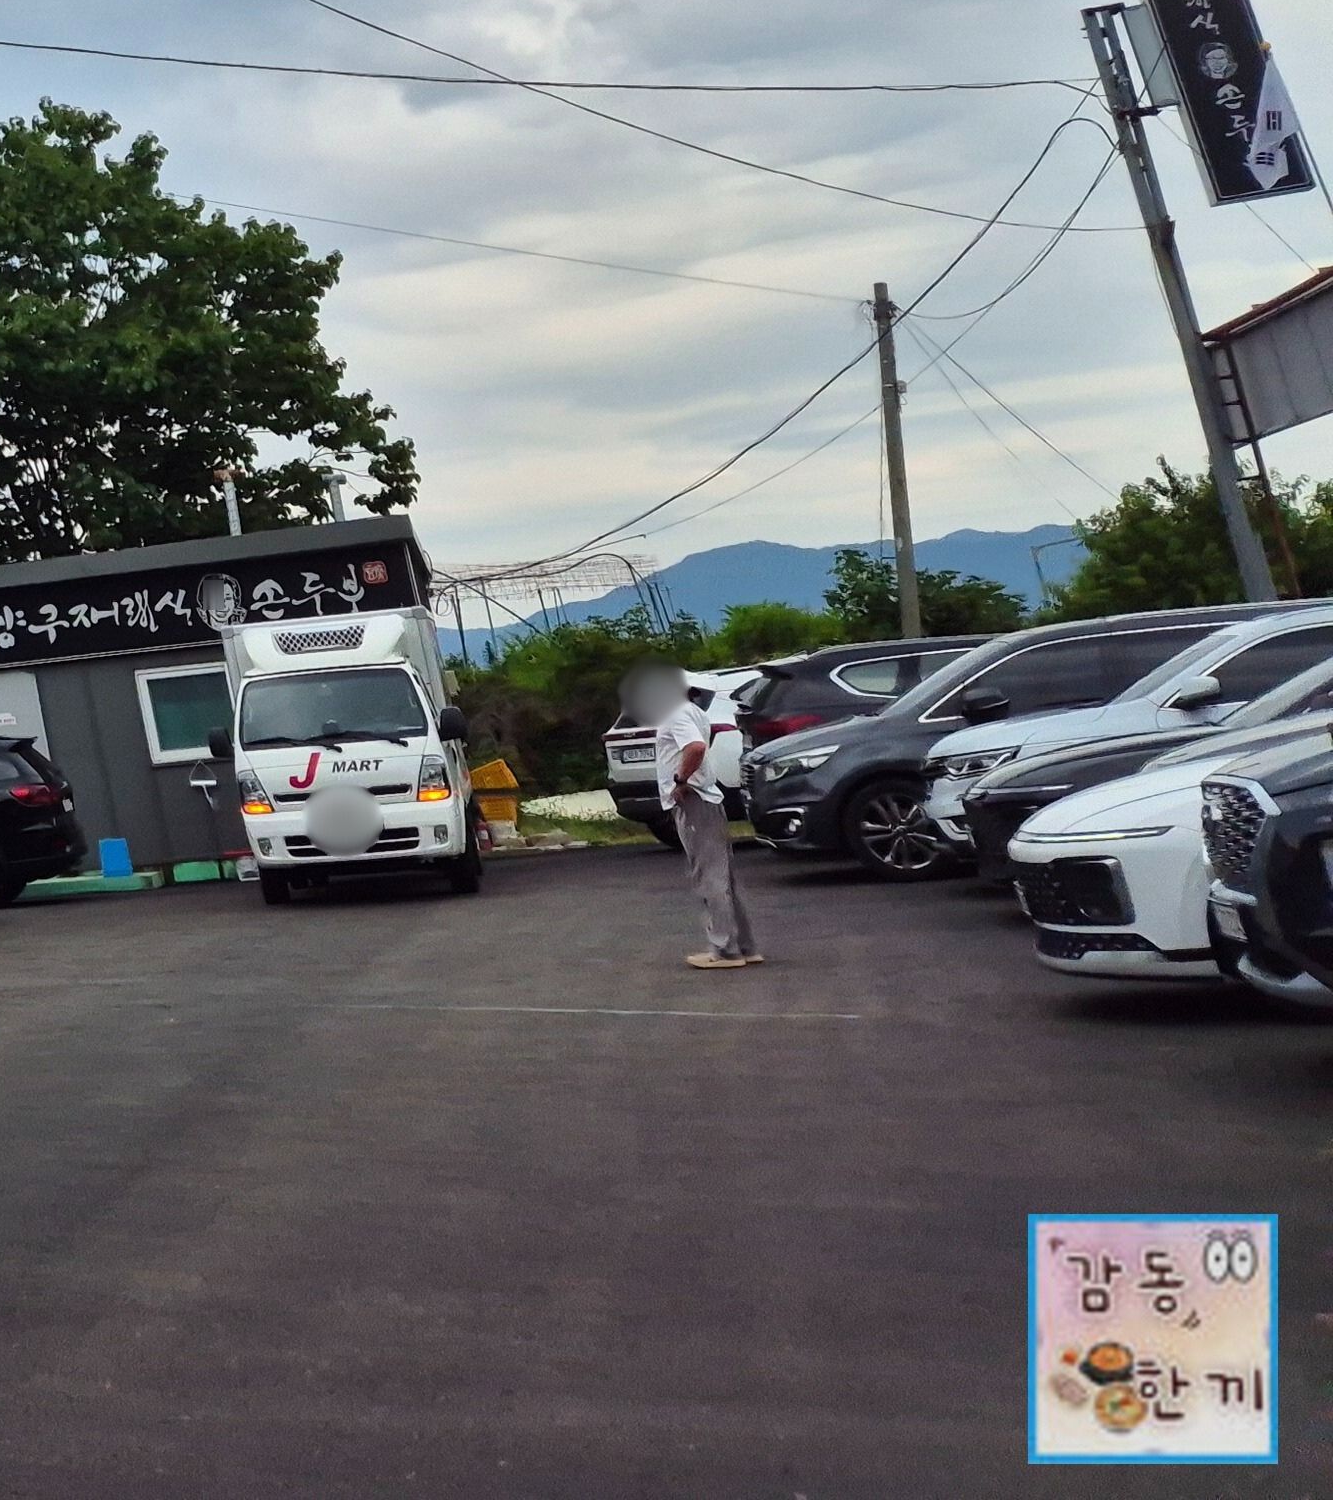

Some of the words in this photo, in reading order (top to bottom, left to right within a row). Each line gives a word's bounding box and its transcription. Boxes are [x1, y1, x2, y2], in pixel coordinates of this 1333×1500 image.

[250, 563, 365, 620] 손두부
[288, 751, 322, 790] J
[331, 759, 384, 773] MART
